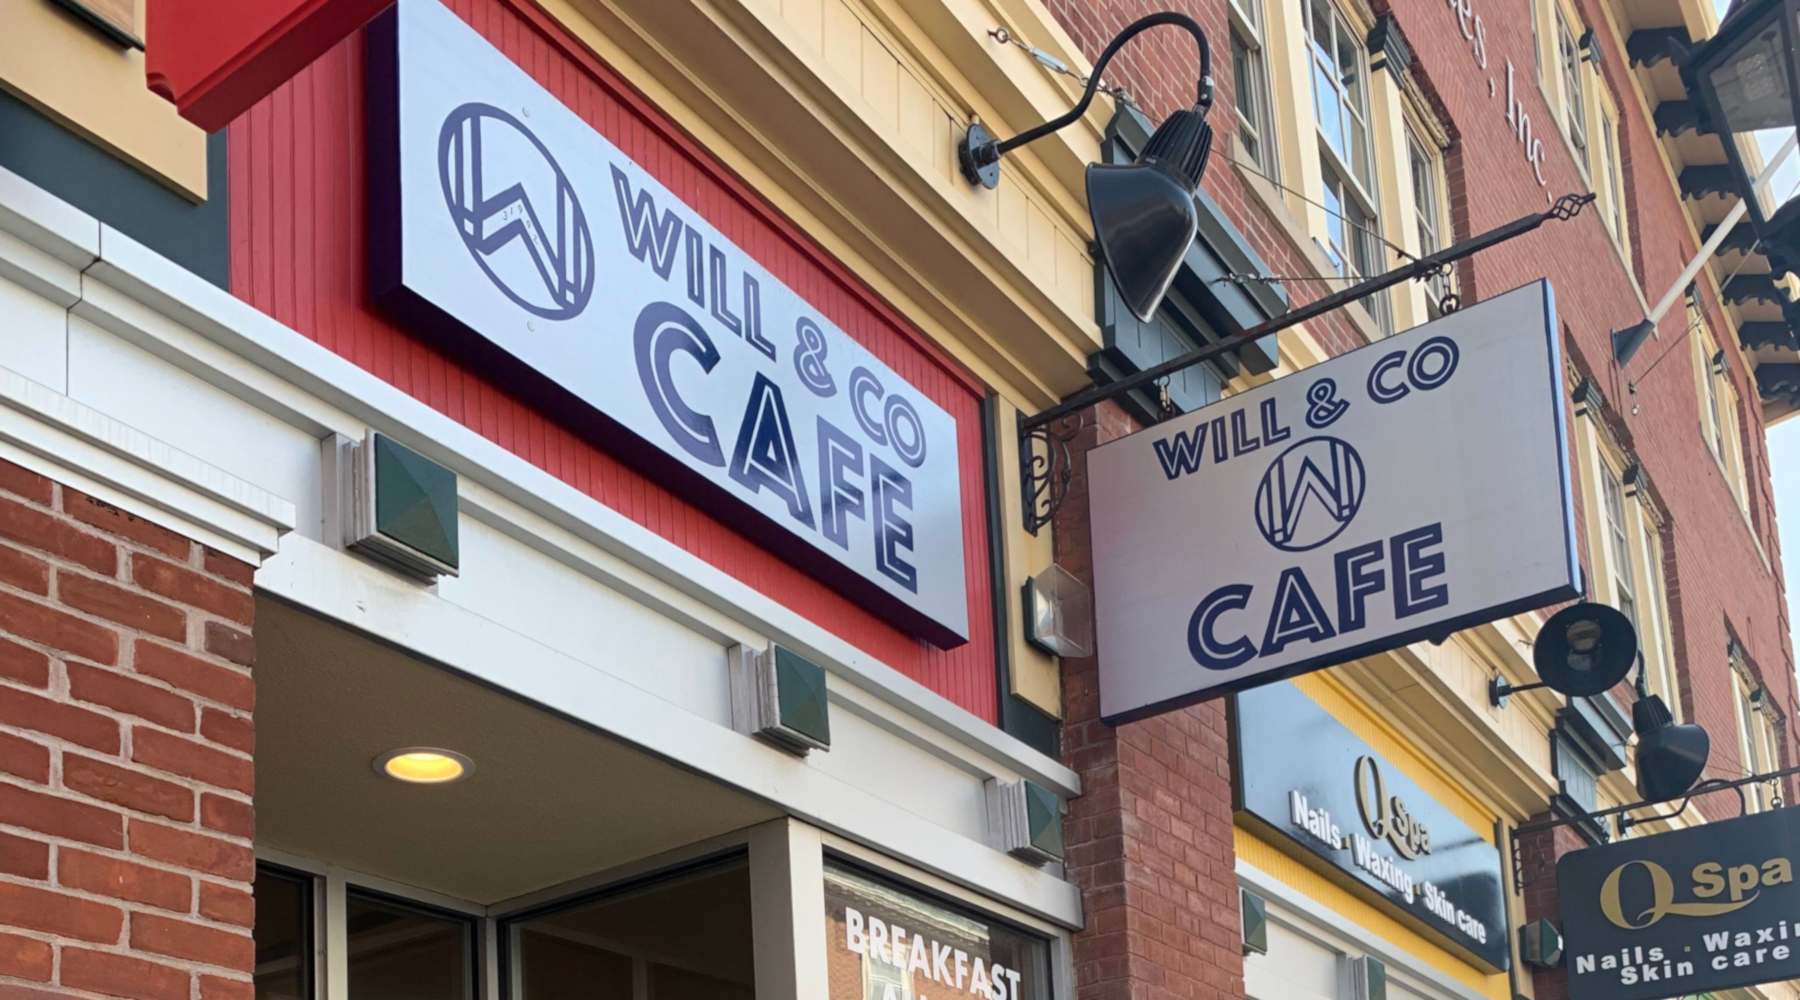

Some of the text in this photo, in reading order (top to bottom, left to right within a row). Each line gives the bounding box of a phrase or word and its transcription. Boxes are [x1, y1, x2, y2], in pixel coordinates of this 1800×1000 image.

[609, 161, 927, 469] WILL & CO
[633, 301, 918, 595] CAFE
[1152, 336, 1460, 480] WILL & CO
[1187, 522, 1449, 671] CAFE
[1290, 789, 1487, 944] Nails Waxing Skin care
[1354, 755, 1432, 861] Q Spa
[1692, 858, 1793, 901] Spa
[845, 906, 1021, 1000] BREAKFAST
[1576, 920, 1800, 974] Nails Waxi
[1621, 945, 1790, 985] Skin care
